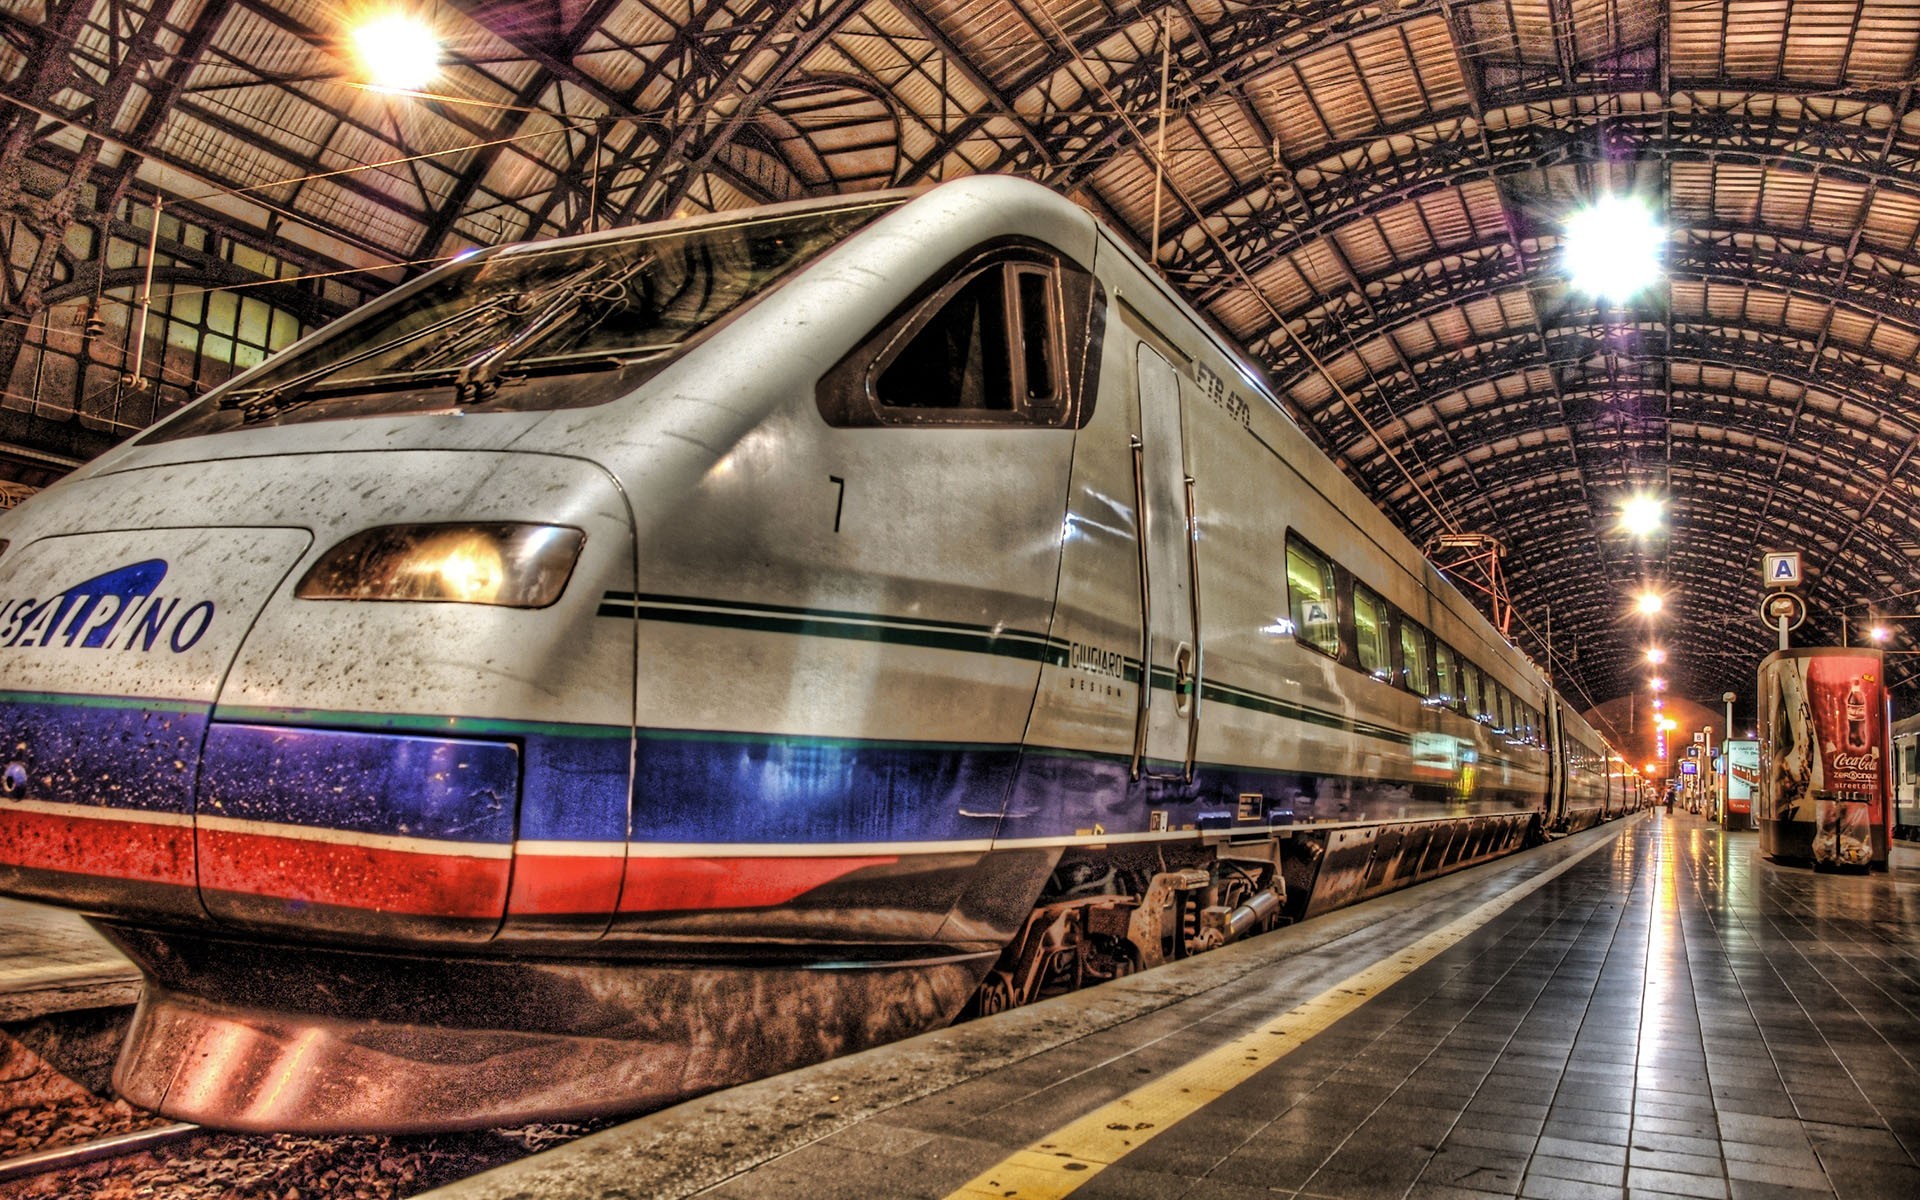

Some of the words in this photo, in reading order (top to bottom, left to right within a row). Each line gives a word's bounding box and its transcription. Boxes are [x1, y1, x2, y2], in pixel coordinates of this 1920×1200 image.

[1196, 361, 1224, 409] ETR
[1775, 559, 1793, 577] A
[1071, 642, 1122, 678] GIUGIARO
[1070, 677, 1121, 697] DESIGN
[1833, 753, 1878, 770] Coca-Cola
